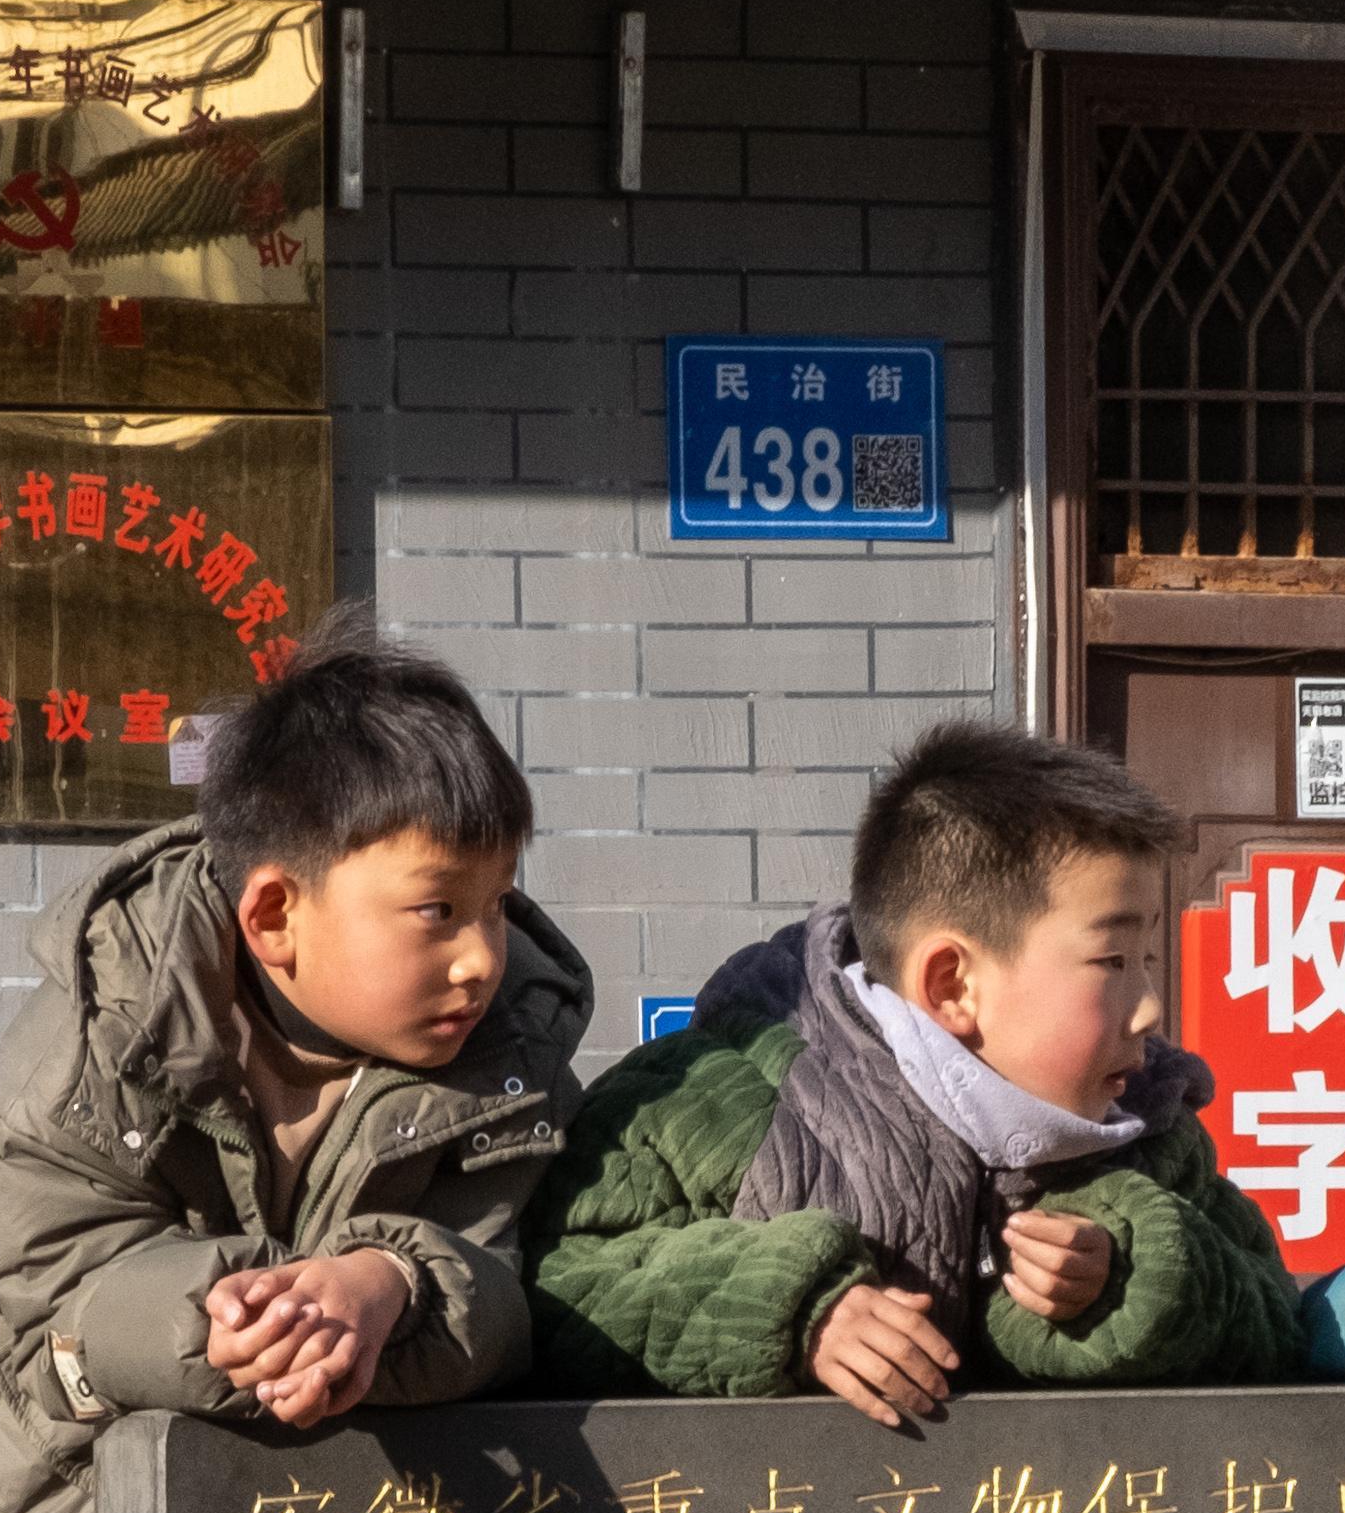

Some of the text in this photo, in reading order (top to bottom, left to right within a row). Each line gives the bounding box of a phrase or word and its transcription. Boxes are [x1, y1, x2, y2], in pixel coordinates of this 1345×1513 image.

[714, 362, 903, 403] 民治街
[705, 426, 844, 513] 438
